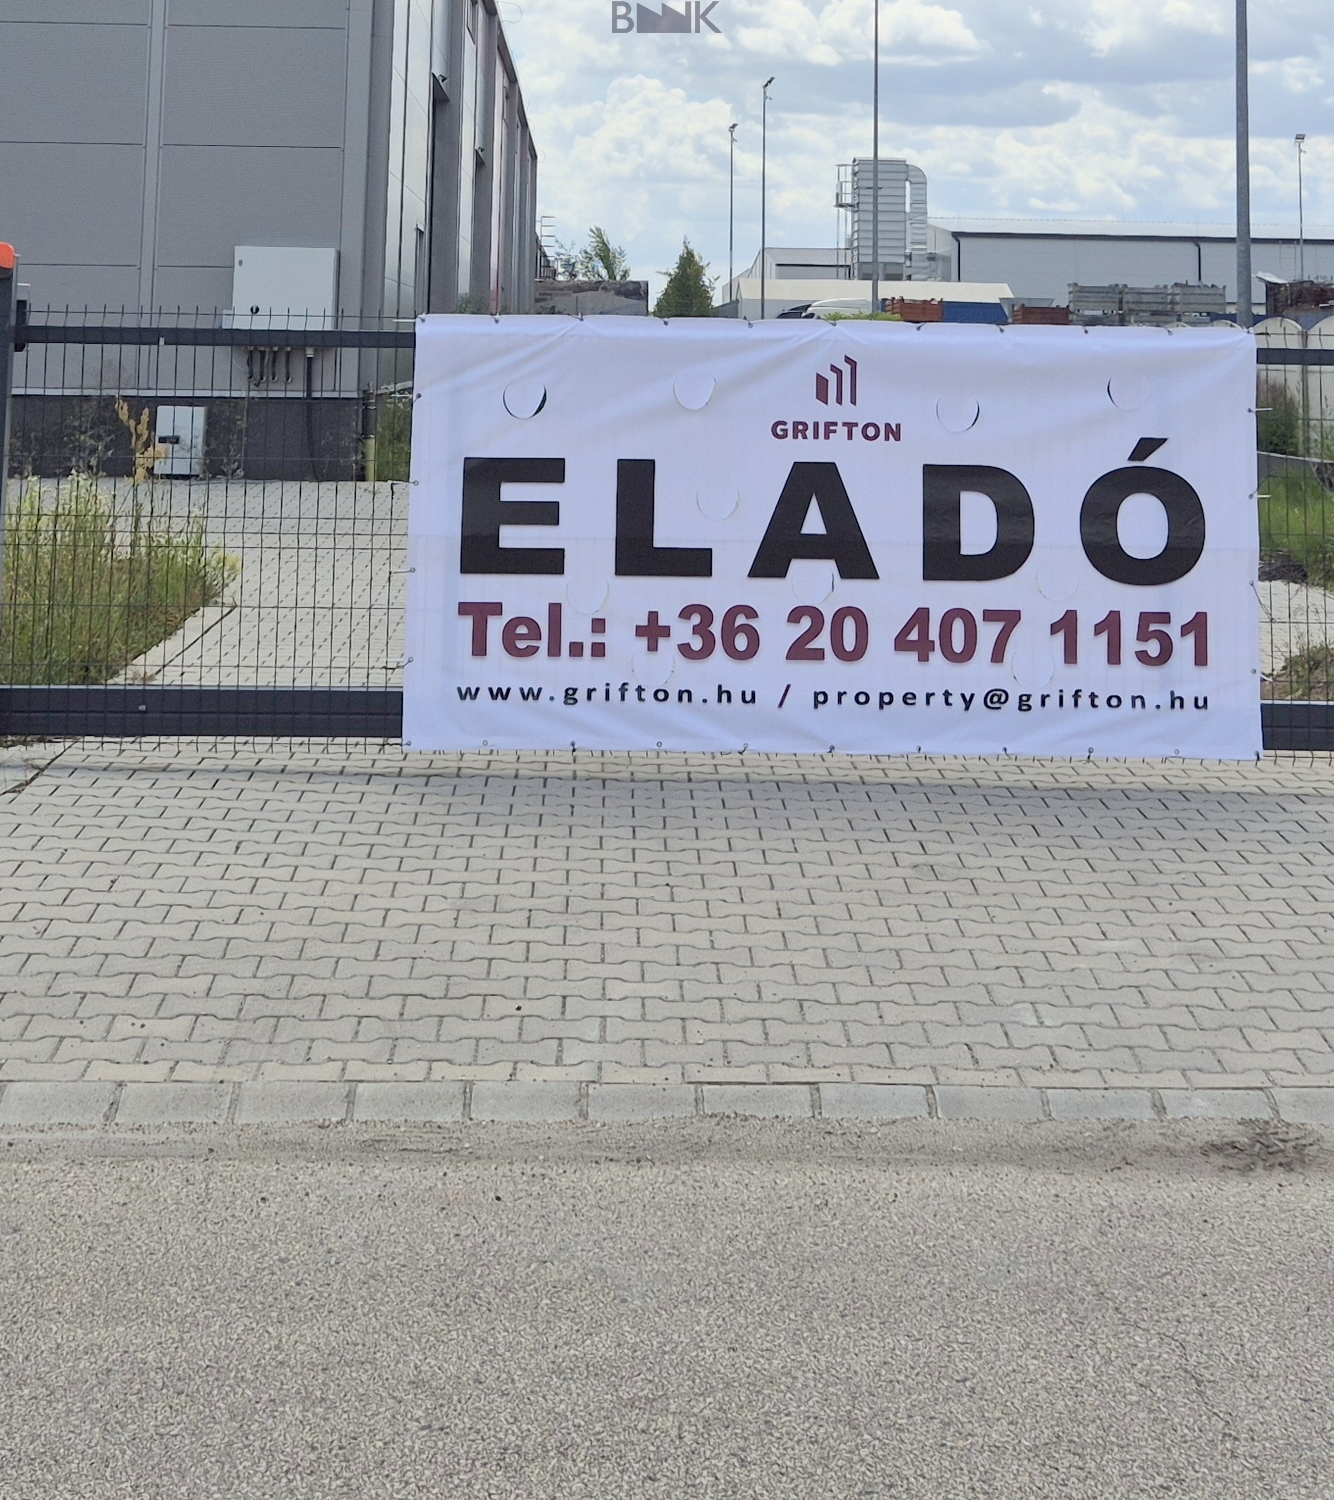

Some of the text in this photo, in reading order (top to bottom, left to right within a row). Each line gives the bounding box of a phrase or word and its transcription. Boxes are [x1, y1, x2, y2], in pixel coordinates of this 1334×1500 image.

[771, 421, 902, 442] GRIFTON
[459, 437, 1206, 586] ELADÓ
[457, 601, 1208, 666] Tel.: +36 20 407 1151
[456, 681, 1208, 713] www.grifton.hu / property@grifton.hu
